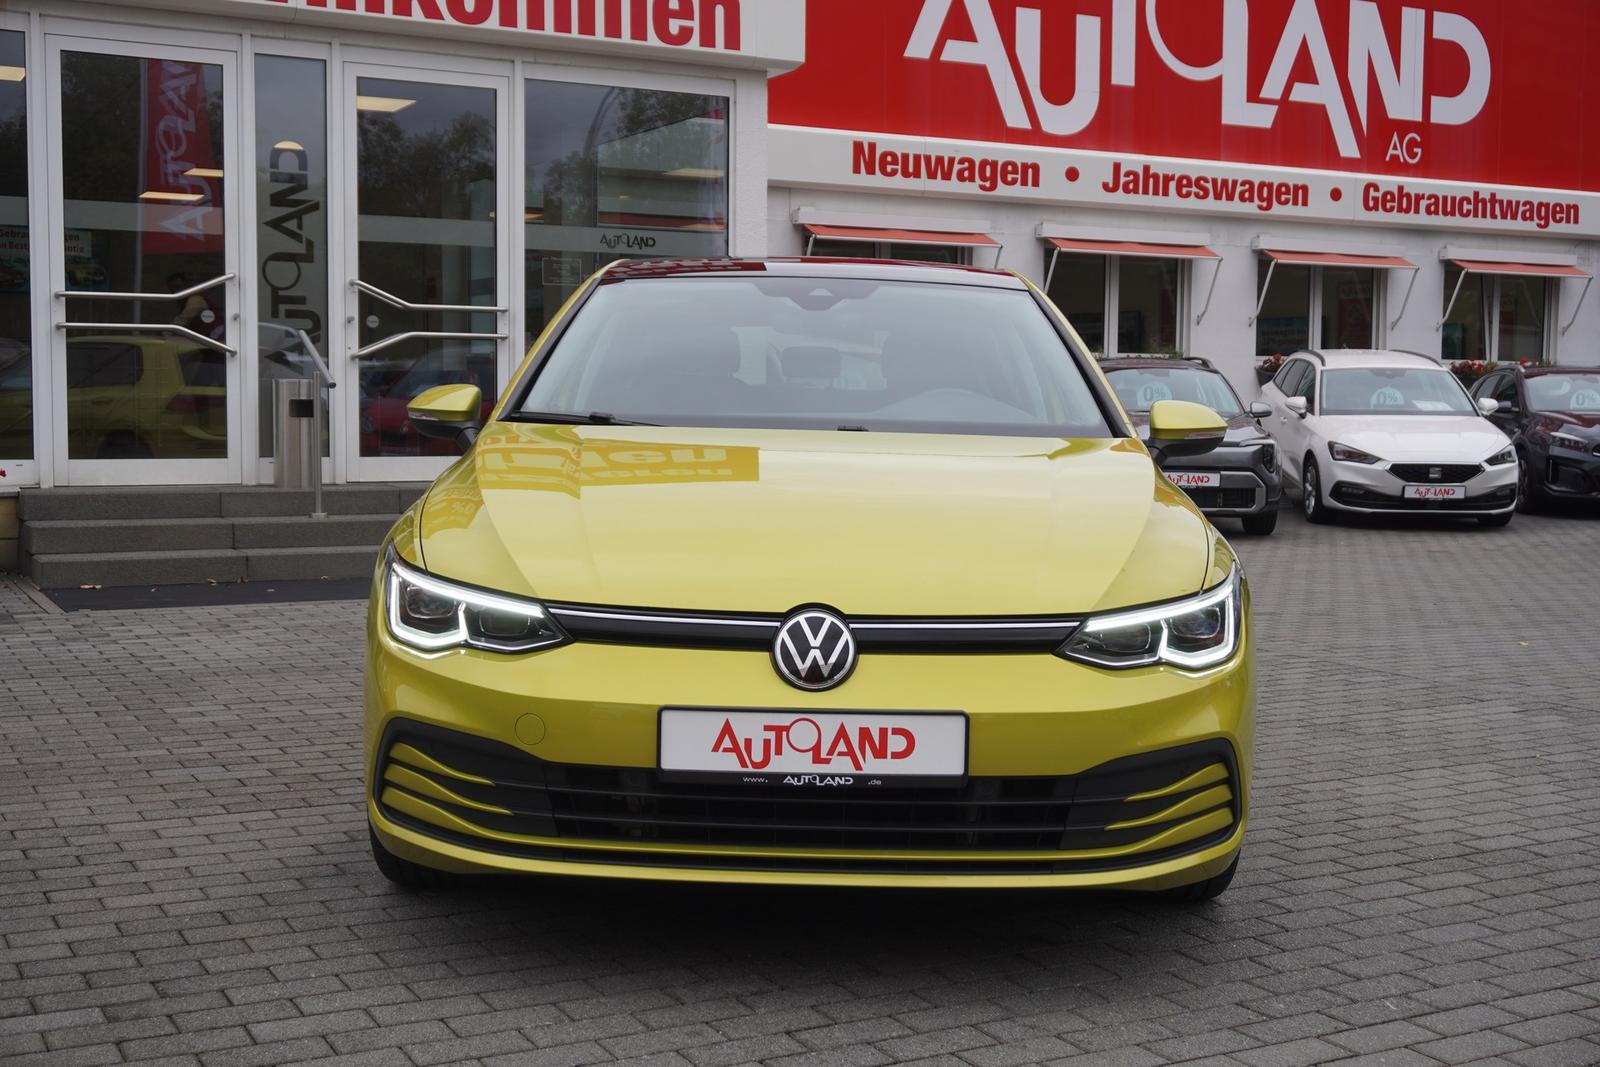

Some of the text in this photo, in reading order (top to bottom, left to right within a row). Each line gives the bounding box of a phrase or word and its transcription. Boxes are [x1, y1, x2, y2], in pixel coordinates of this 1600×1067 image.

[904, 0, 1491, 158] AUTOLAND
[1385, 132, 1422, 164] AG
[852, 140, 1580, 230] Neuwagen Jahreswagen Gebrauchtwagen
[261, 140, 322, 377] AUTOLAND
[600, 233, 657, 250] AUTOLAND
[1143, 385, 1167, 401] 0%
[711, 717, 917, 772] AUTOLAND
[742, 776, 769, 784] www.
[783, 774, 854, 787] AUTOLAND
